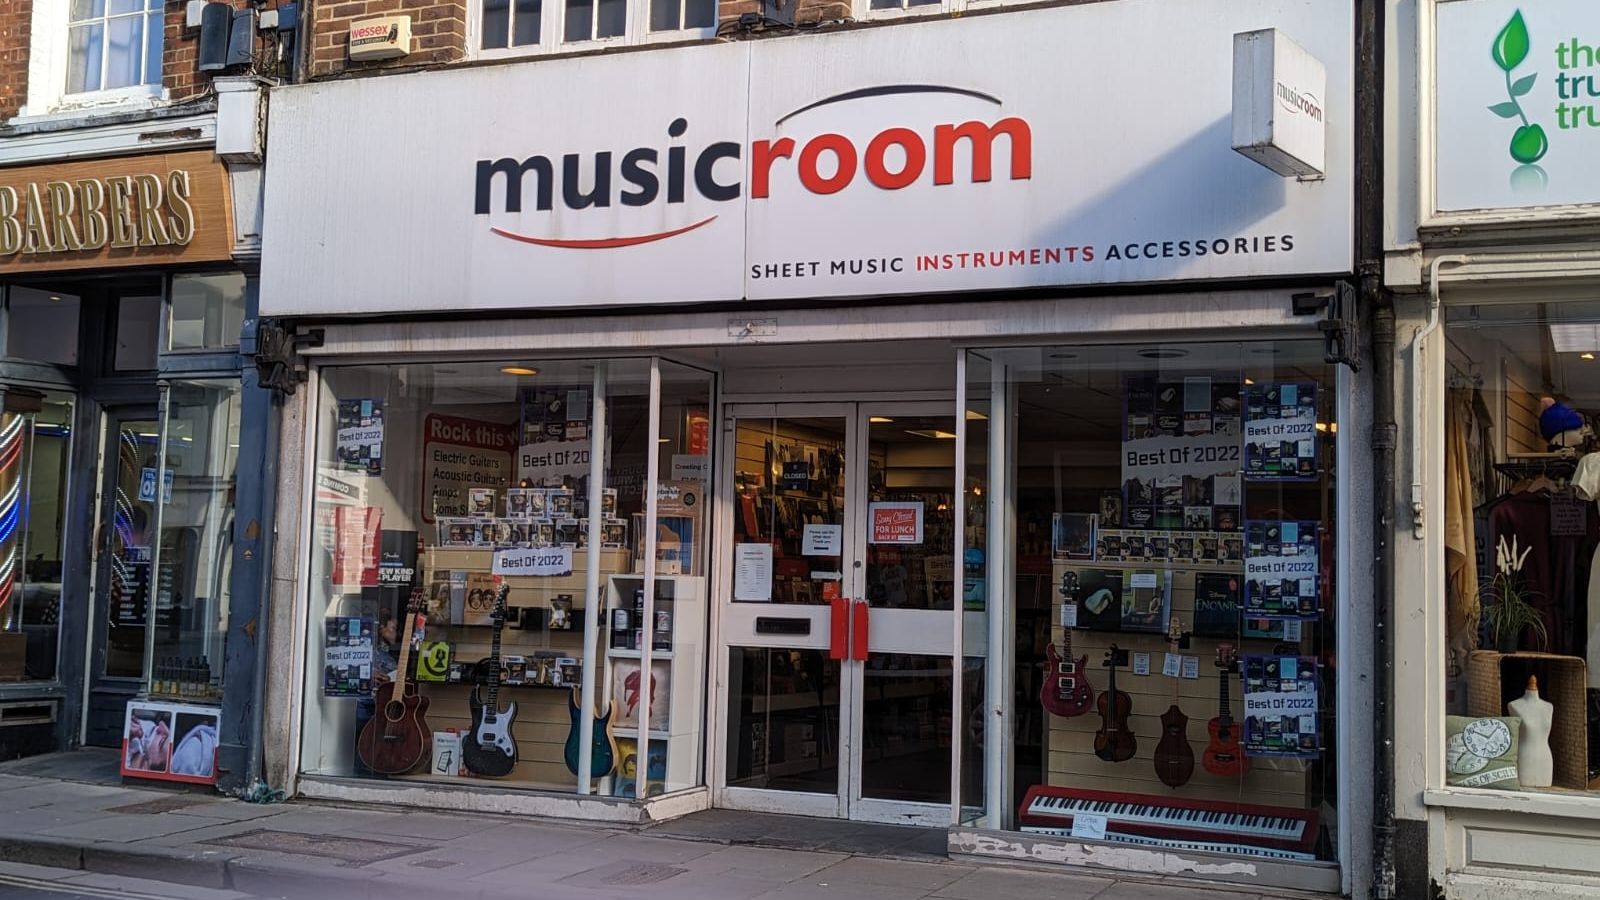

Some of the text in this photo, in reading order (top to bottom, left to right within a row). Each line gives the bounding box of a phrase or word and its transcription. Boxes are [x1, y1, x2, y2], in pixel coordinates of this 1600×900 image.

[351, 25, 388, 39] wessex
[1555, 37, 1600, 69] th
[1277, 82, 1322, 122] musicroom
[475, 117, 1032, 214] musicroom
[0, 170, 194, 255] BARBERS
[751, 235, 1294, 279] SHEET MUSIC INSTRUMENTS ACCESSORIES
[339, 430, 381, 441] Best Of 2022
[431, 418, 471, 442] Rock
[475, 426, 504, 446] this
[1248, 423, 1313, 436] Best Of 2022
[433, 449, 500, 468] Electric Guitars
[522, 449, 592, 467] Best Of 20
[1127, 445, 1239, 467] Best Of 2022
[433, 467, 504, 485] Acoustic Guitars
[432, 484, 459, 500] Amps
[875, 525, 915, 534] FOR LUNCH
[502, 554, 564, 568] Best Of 2022
[1248, 562, 1314, 573] Best Of 2022
[382, 574, 412, 582] PLAYER
[394, 567, 414, 575] KIND
[327, 651, 370, 660] Best Of 2022
[1247, 698, 1314, 709] Best Of 2022
